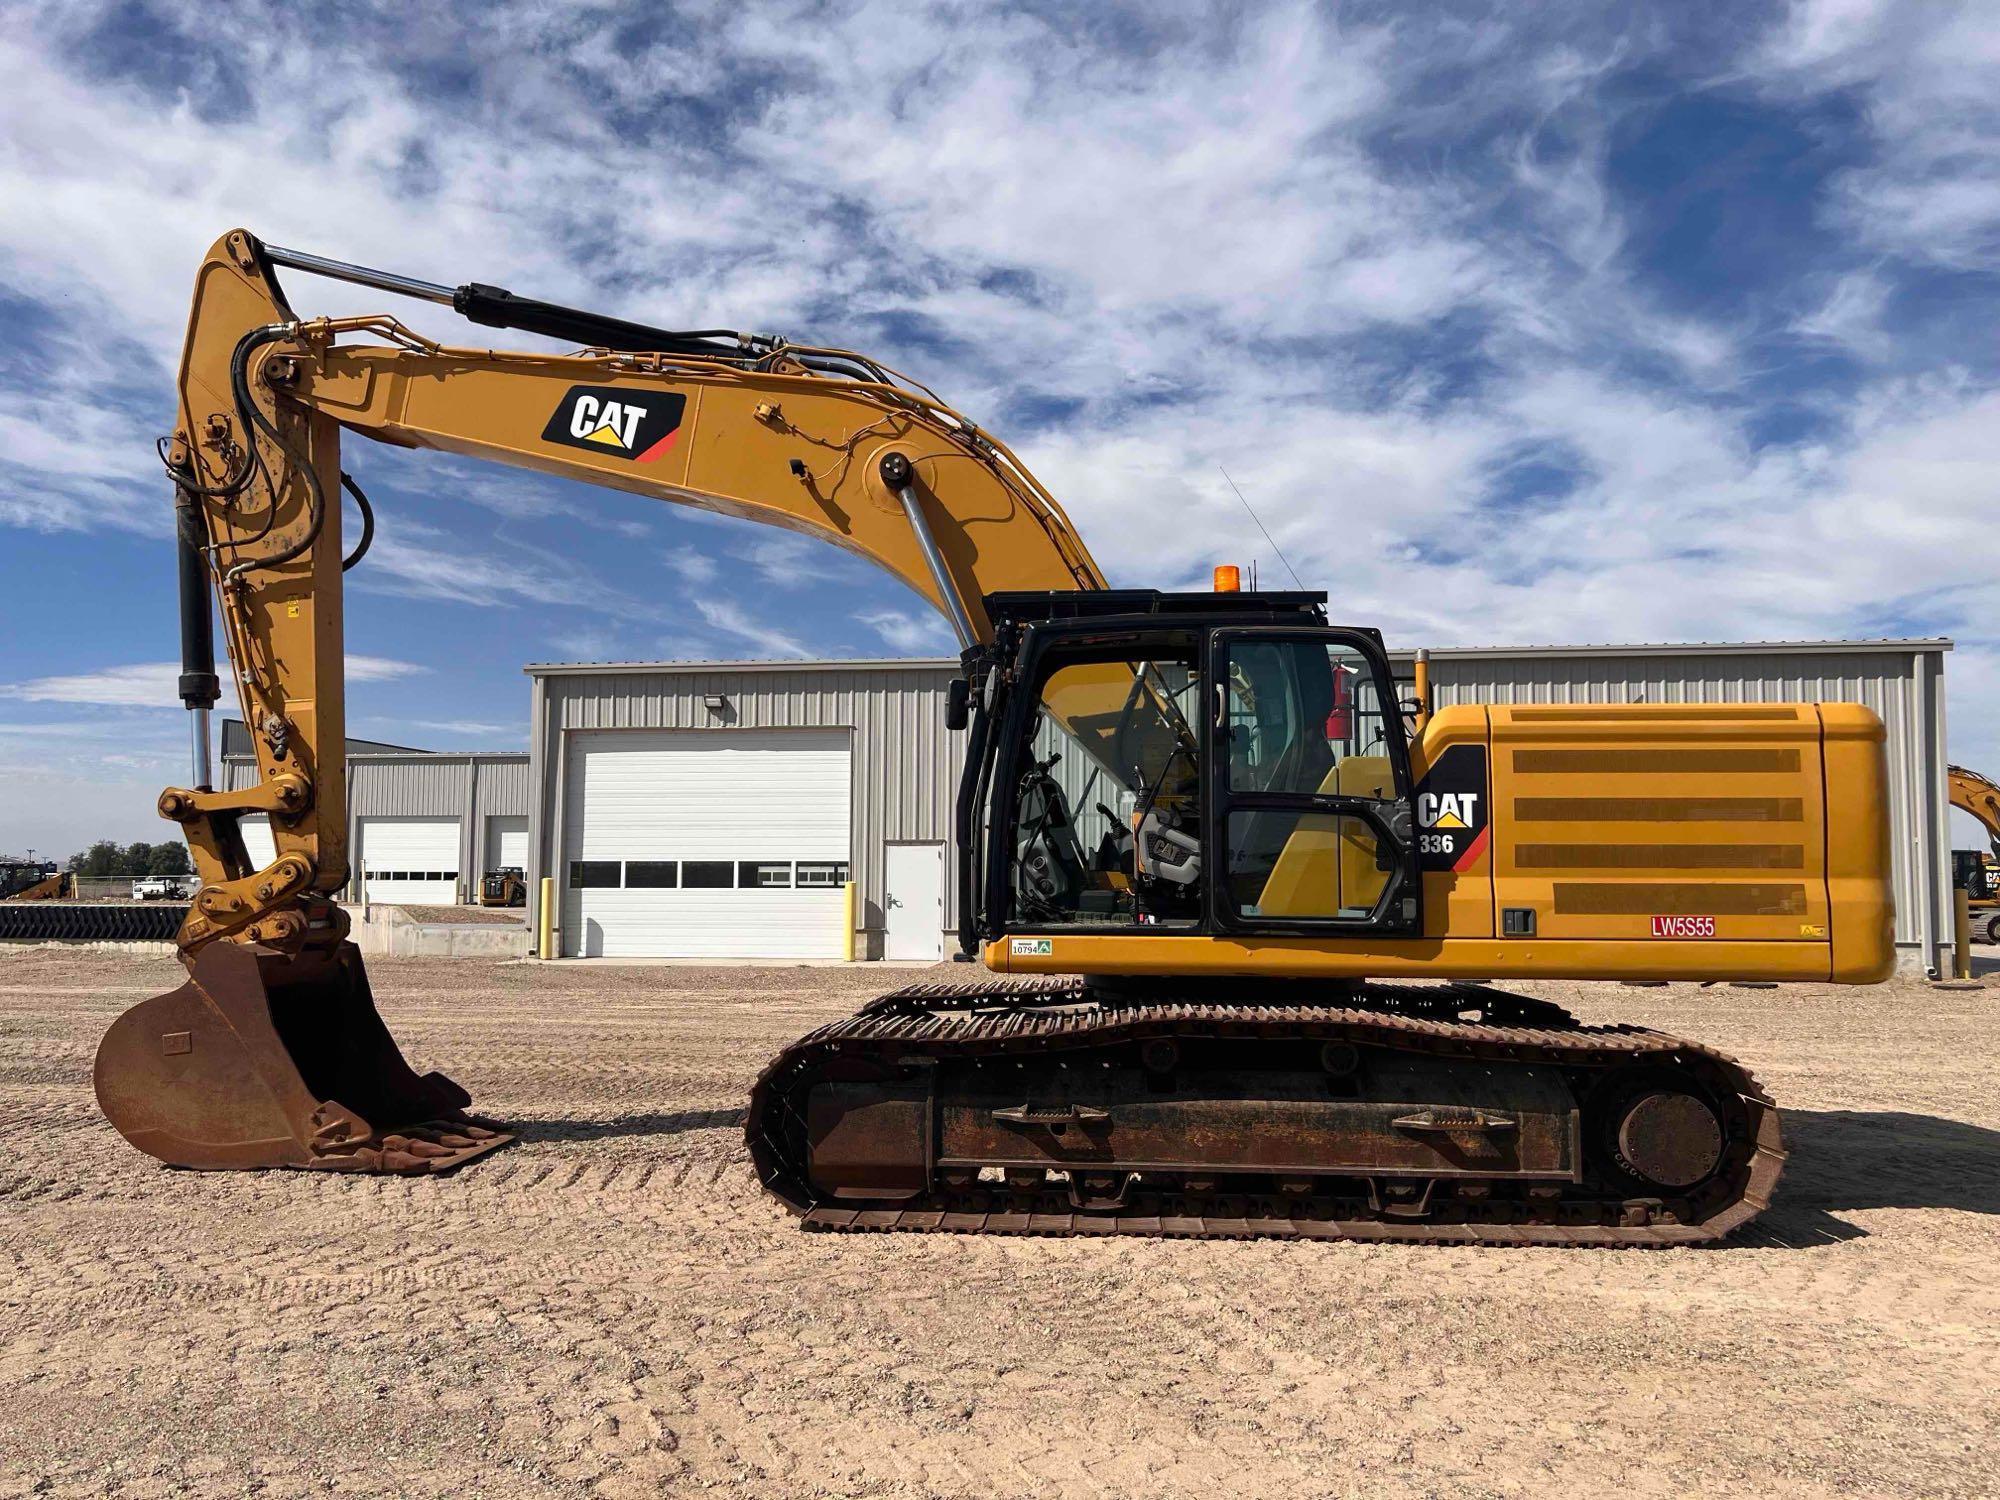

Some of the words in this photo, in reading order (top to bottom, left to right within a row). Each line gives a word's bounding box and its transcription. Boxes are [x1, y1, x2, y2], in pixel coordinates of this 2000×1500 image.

[570, 395, 648, 450] CAT
[1418, 792, 1477, 828] CAT
[1153, 839, 1179, 862] CAT
[1420, 834, 1454, 853] 336
[1986, 872, 2000, 883] CA
[1652, 917, 1714, 936] LW5S55
